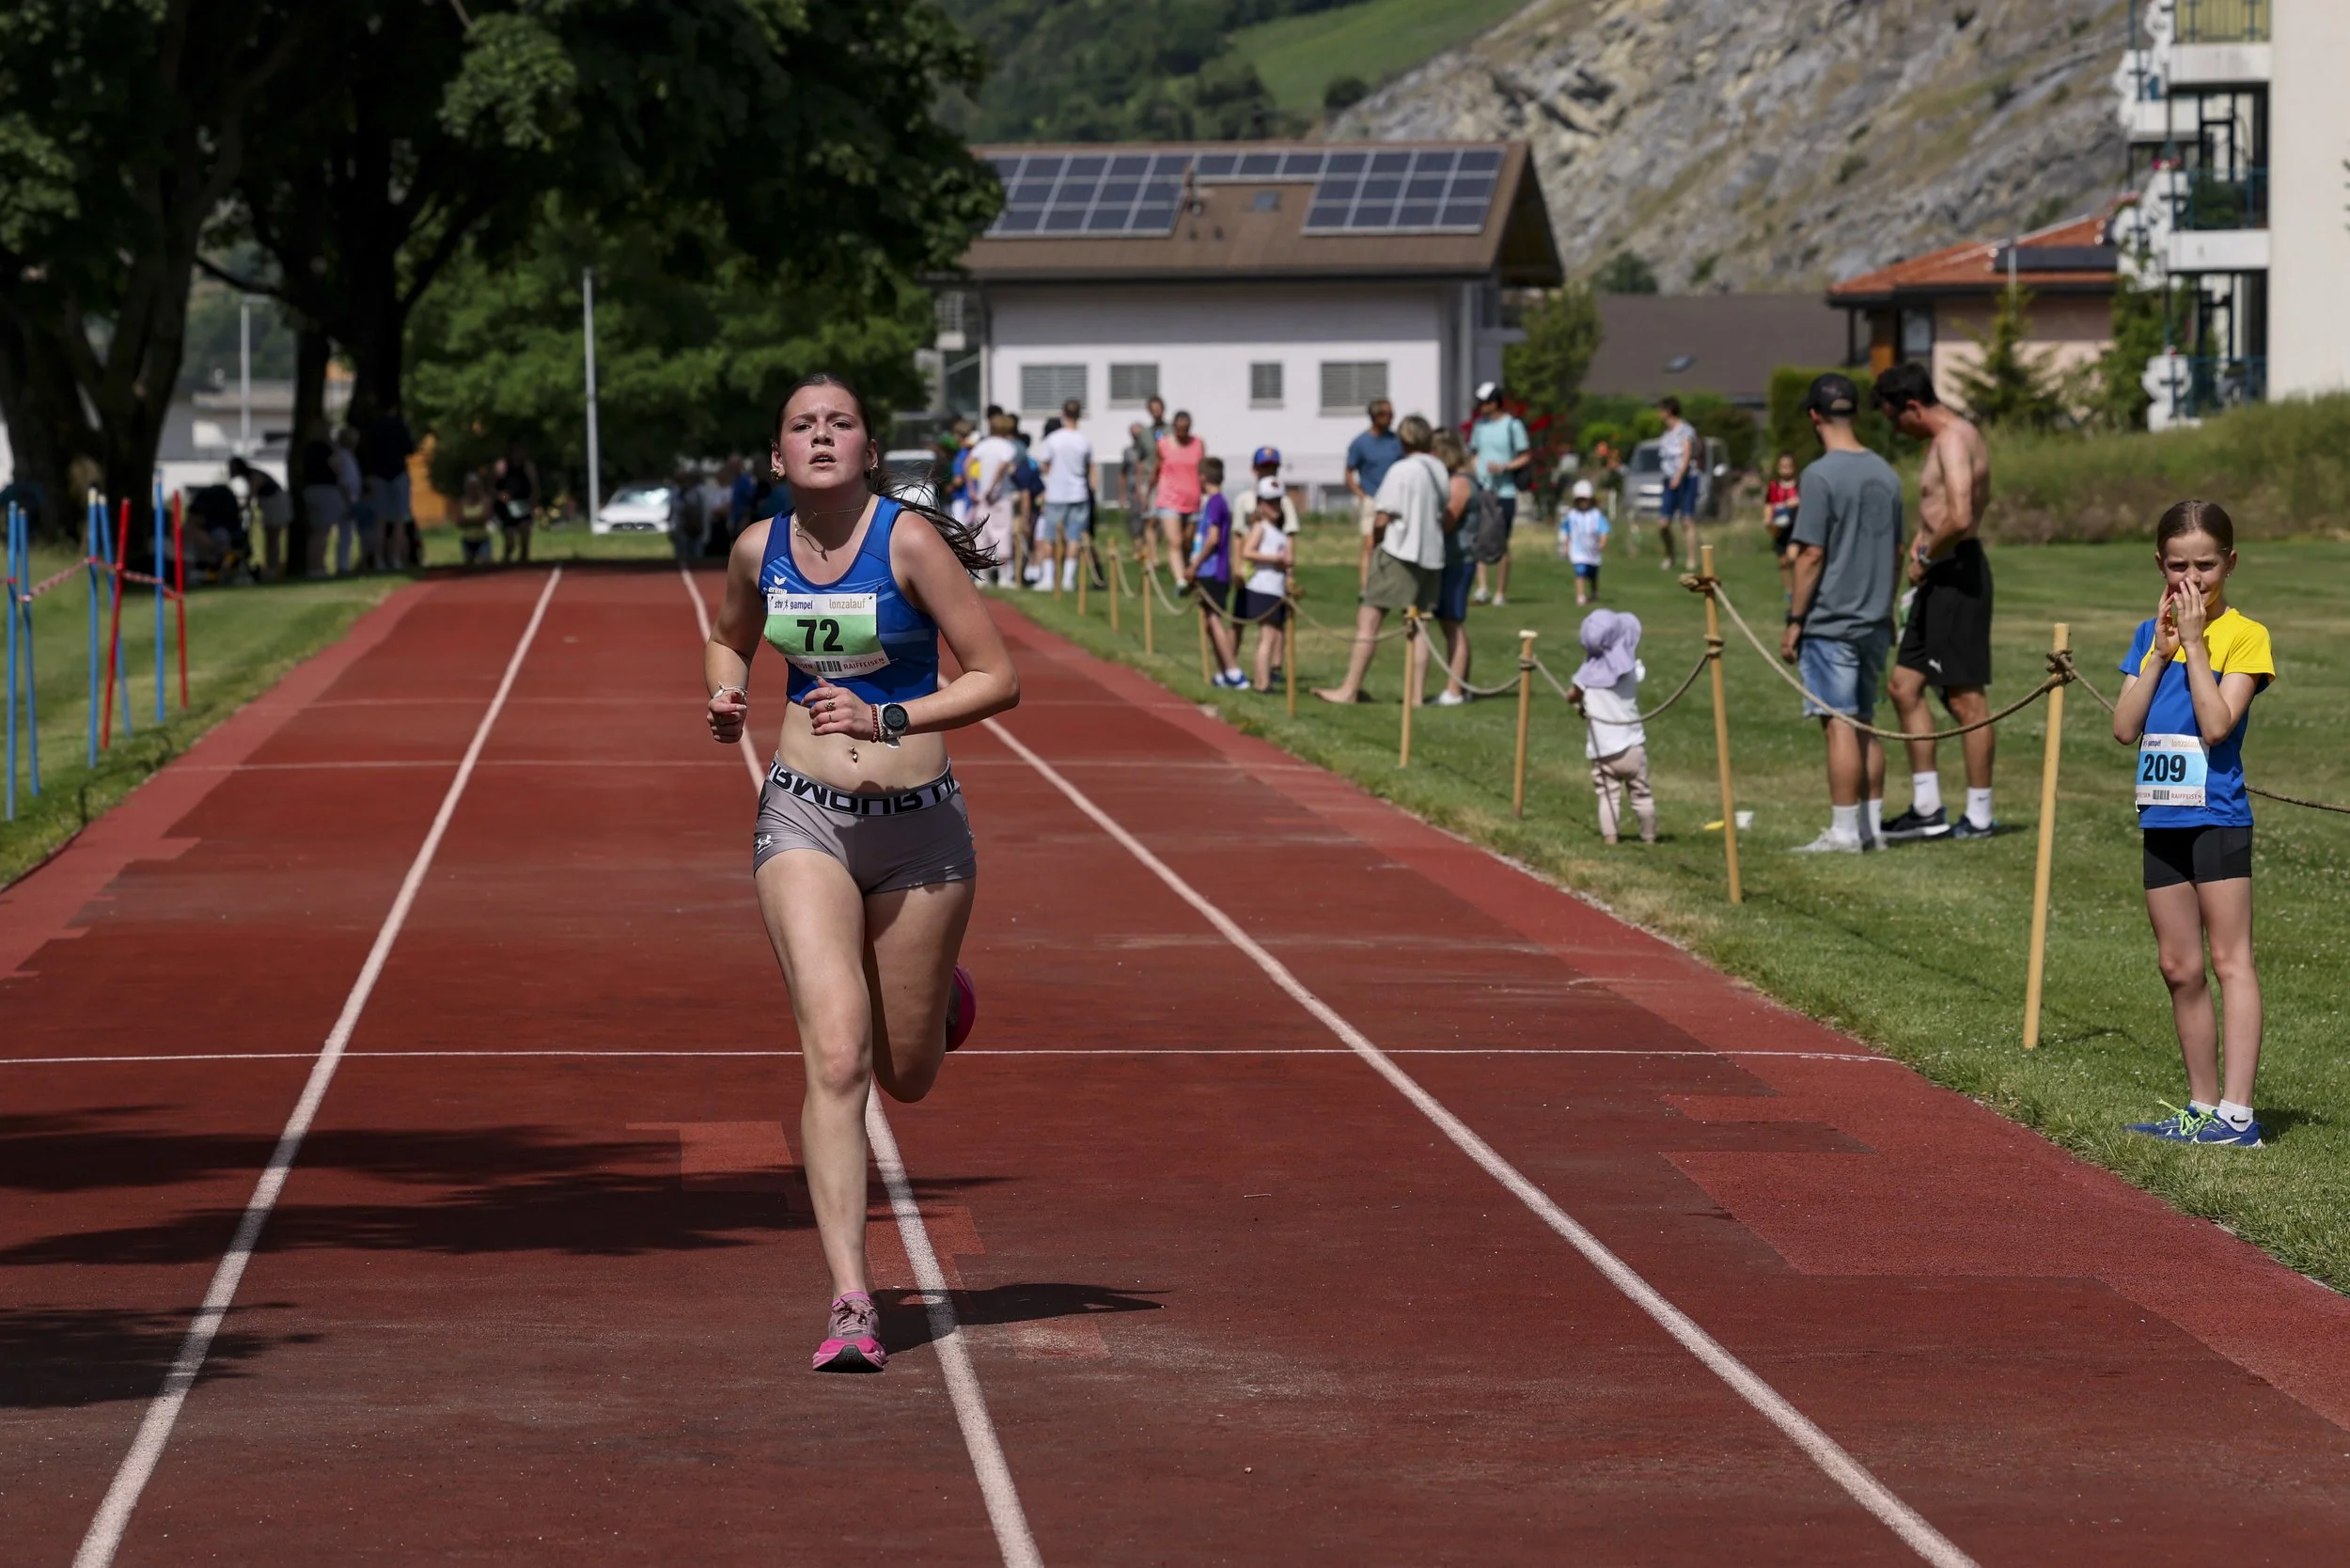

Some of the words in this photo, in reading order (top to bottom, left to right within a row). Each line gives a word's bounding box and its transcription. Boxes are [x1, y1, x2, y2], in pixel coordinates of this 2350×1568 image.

[790, 600, 813, 610] gampel
[829, 599, 867, 609] lonzalauf
[796, 619, 844, 652] 72
[843, 658, 885, 670] RAIFFEISEN
[2142, 754, 2187, 783] 209
